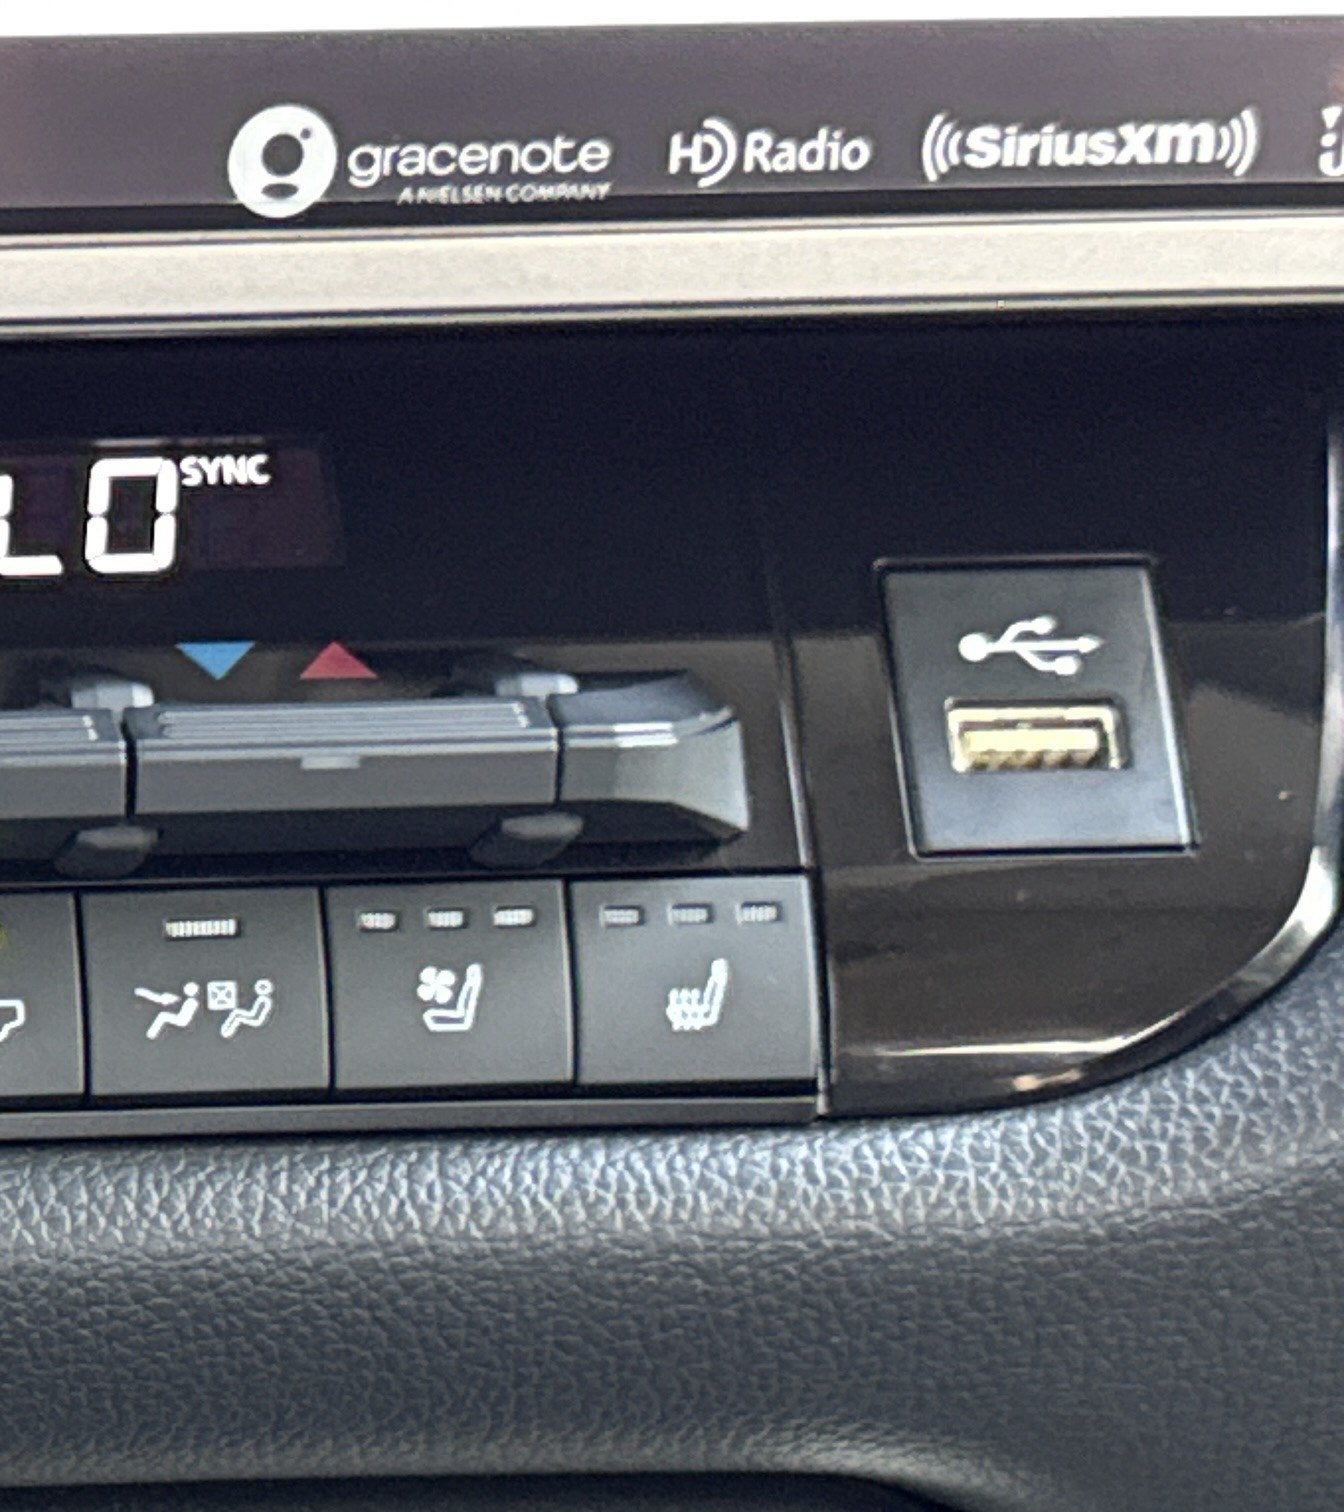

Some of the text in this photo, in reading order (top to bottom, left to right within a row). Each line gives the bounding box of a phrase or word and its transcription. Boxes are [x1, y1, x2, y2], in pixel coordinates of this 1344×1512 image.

[348, 135, 611, 188] gracenote
[743, 127, 871, 173] Radio
[179, 453, 272, 487] SYNC
